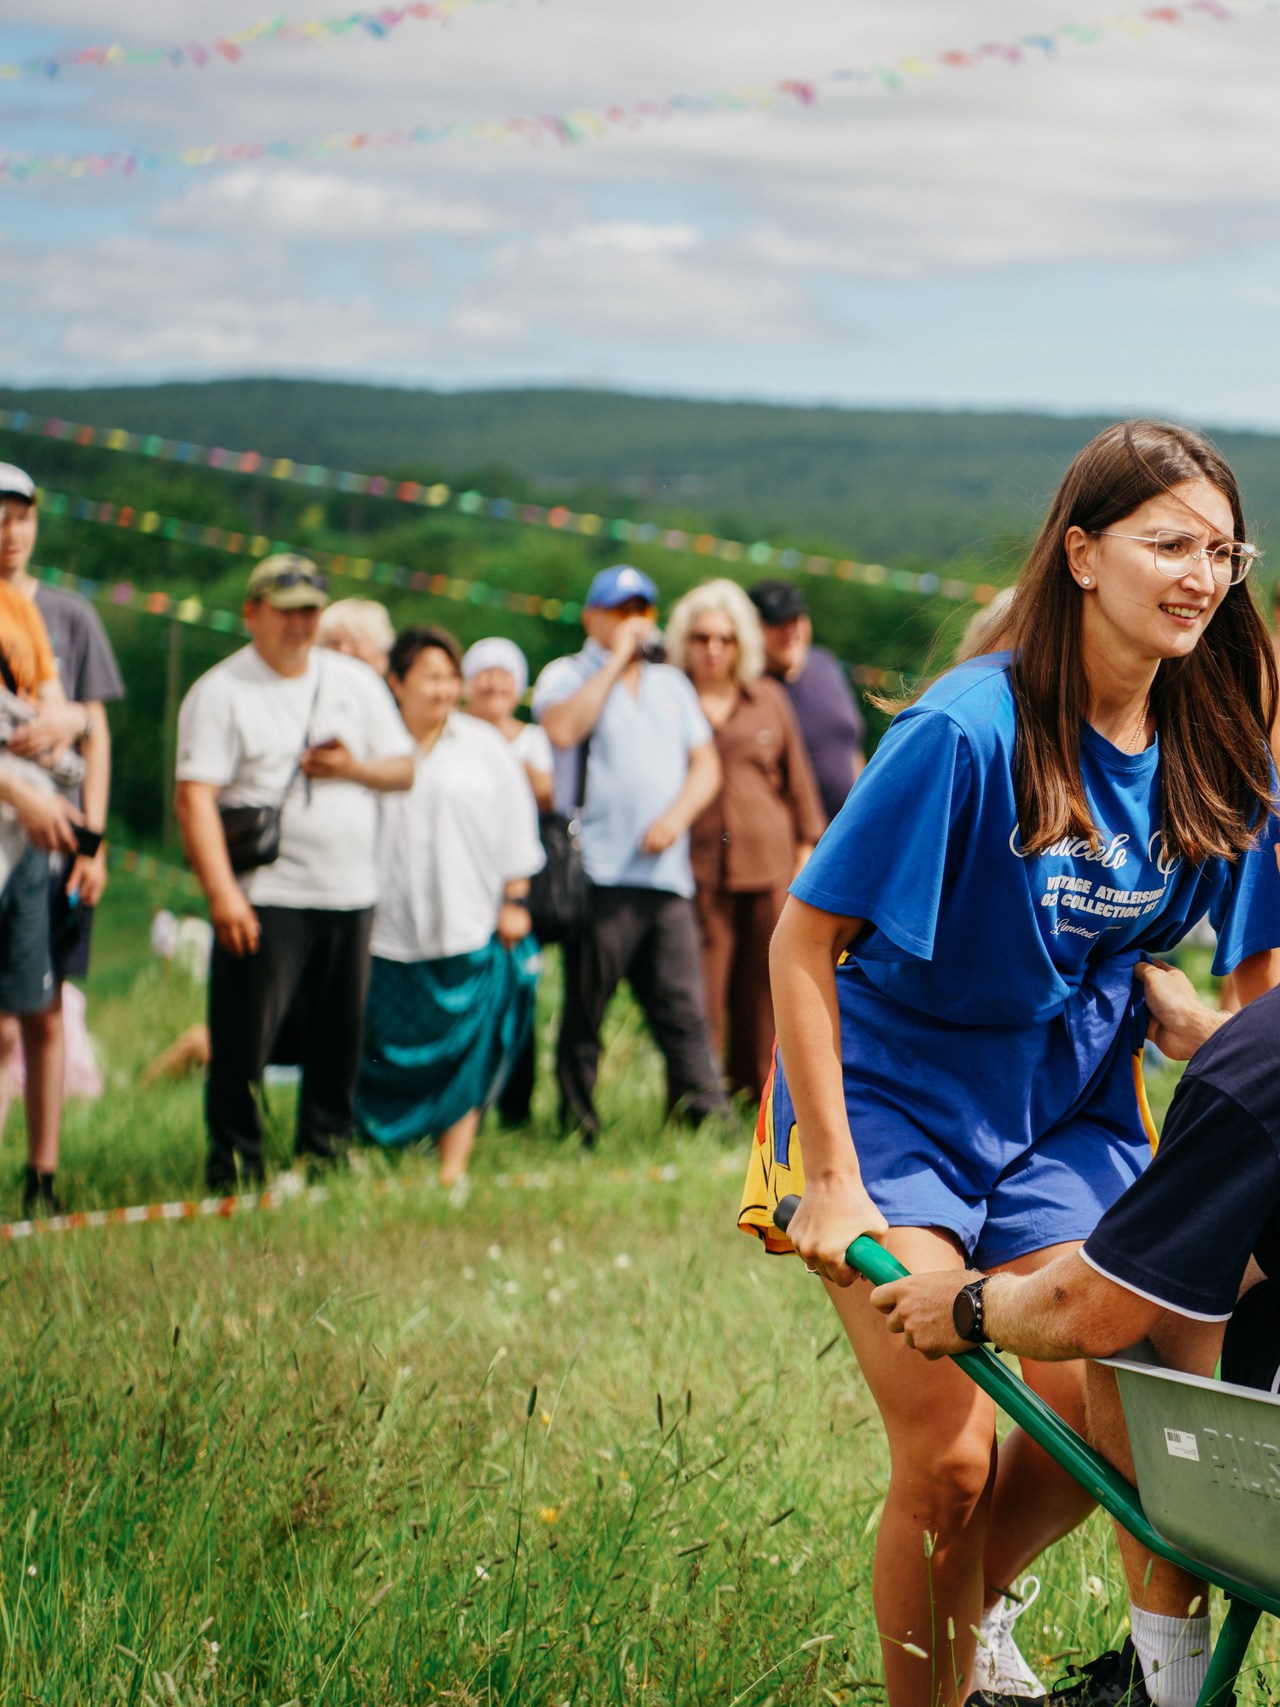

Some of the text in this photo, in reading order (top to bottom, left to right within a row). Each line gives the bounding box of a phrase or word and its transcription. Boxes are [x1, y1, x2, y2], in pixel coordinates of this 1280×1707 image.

[1095, 885, 1167, 904] ATHLEISURE
[1061, 893, 1141, 919] COLLECTION,
[1050, 918, 1100, 938] Limited
